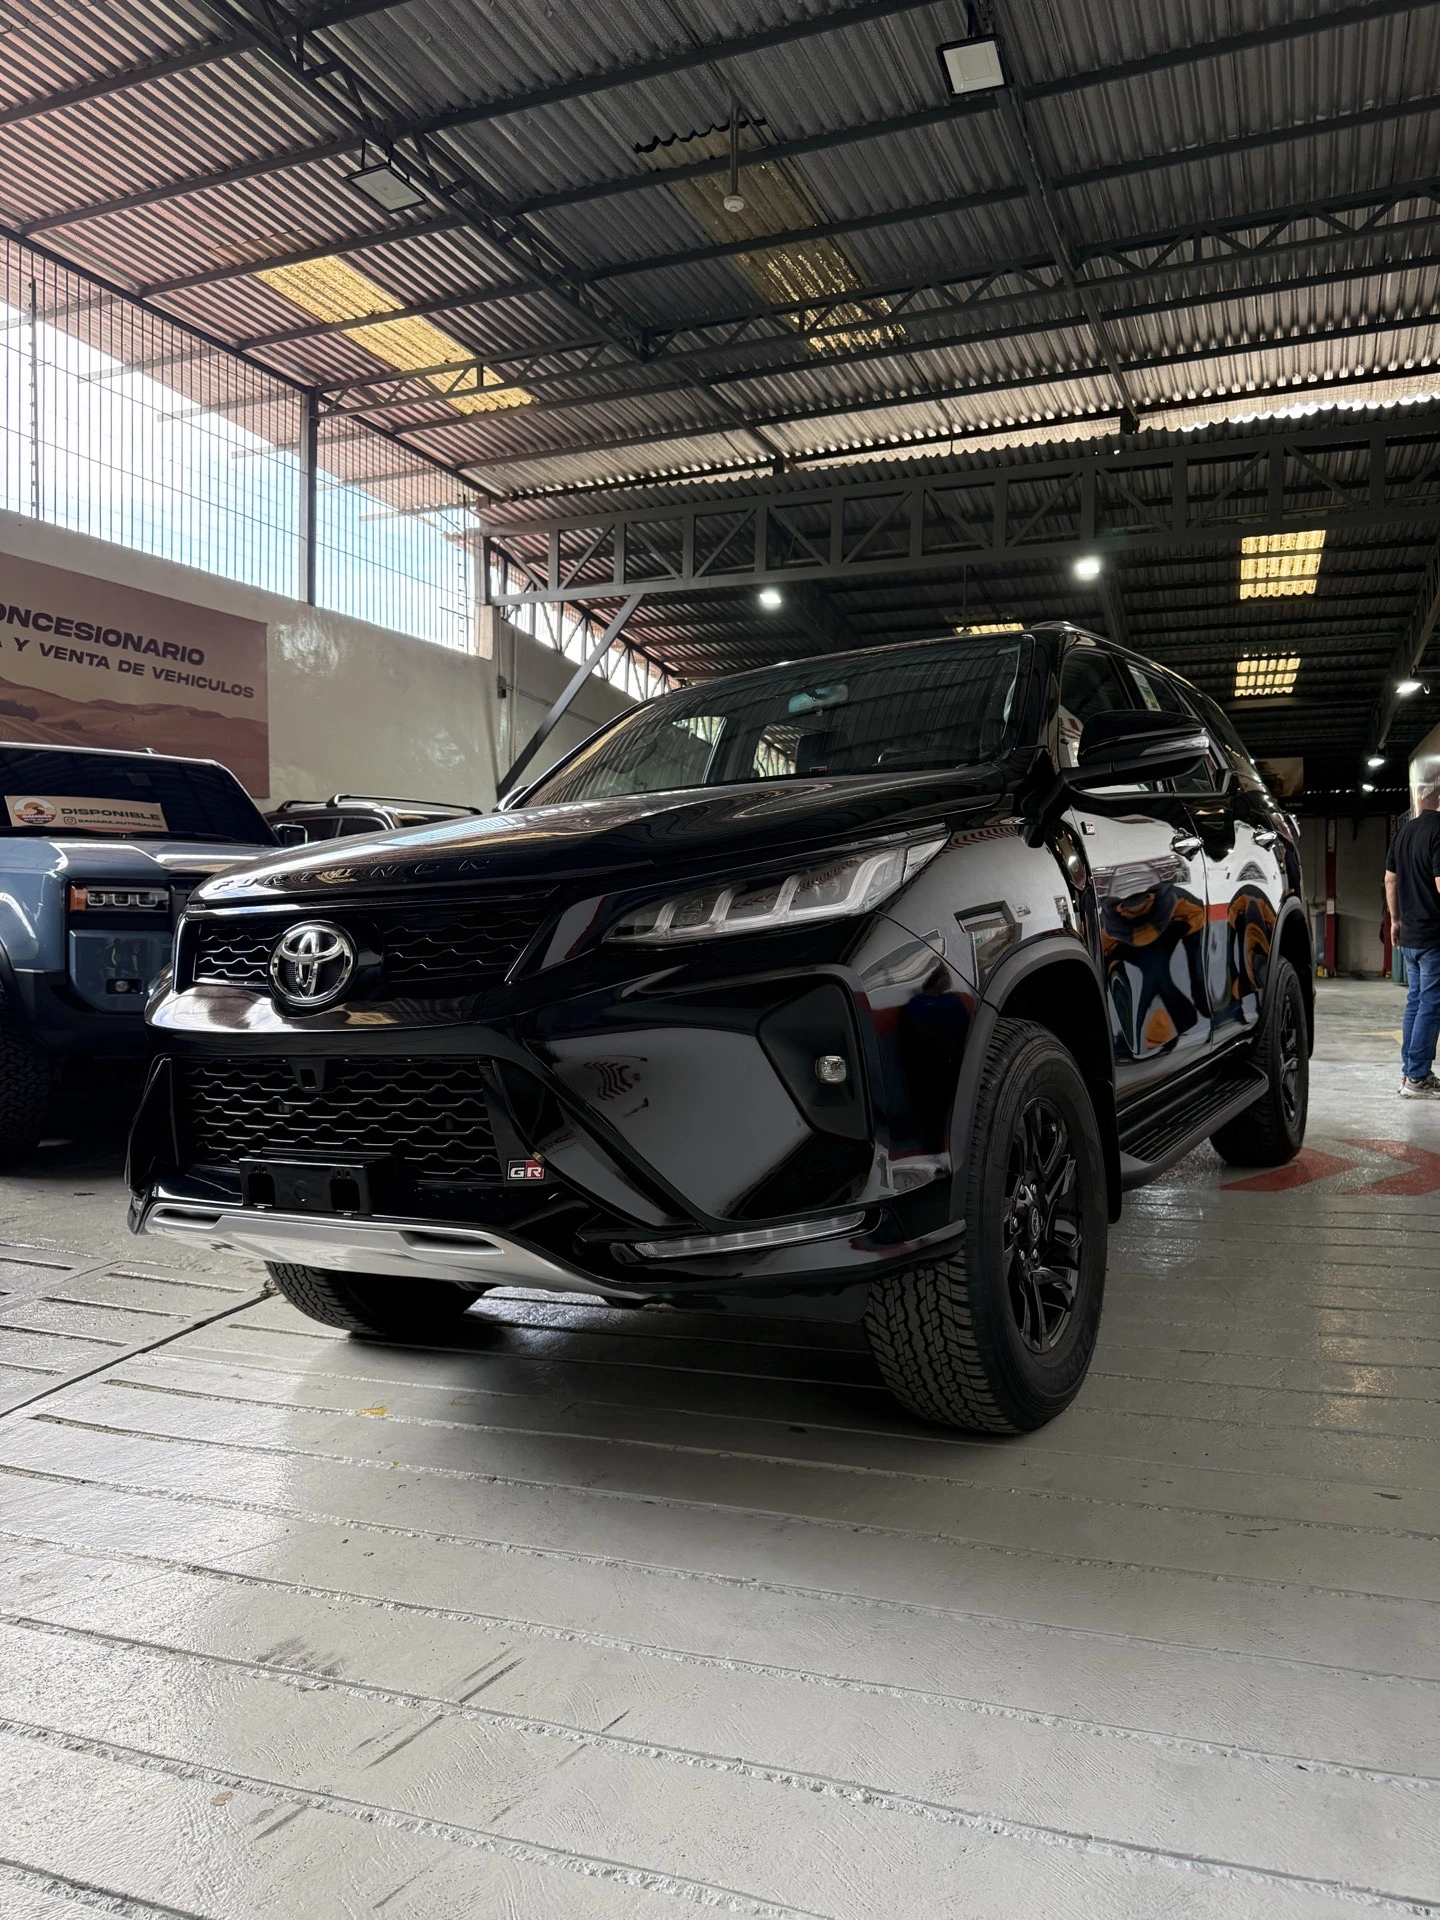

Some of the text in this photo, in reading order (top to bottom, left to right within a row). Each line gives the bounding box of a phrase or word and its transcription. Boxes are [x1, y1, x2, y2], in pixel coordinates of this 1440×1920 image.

[13, 636, 255, 699] Y VENTA DE VEHICULOS
[61, 808, 161, 821] DISPONIBLE
[510, 1167, 542, 1178] GR
